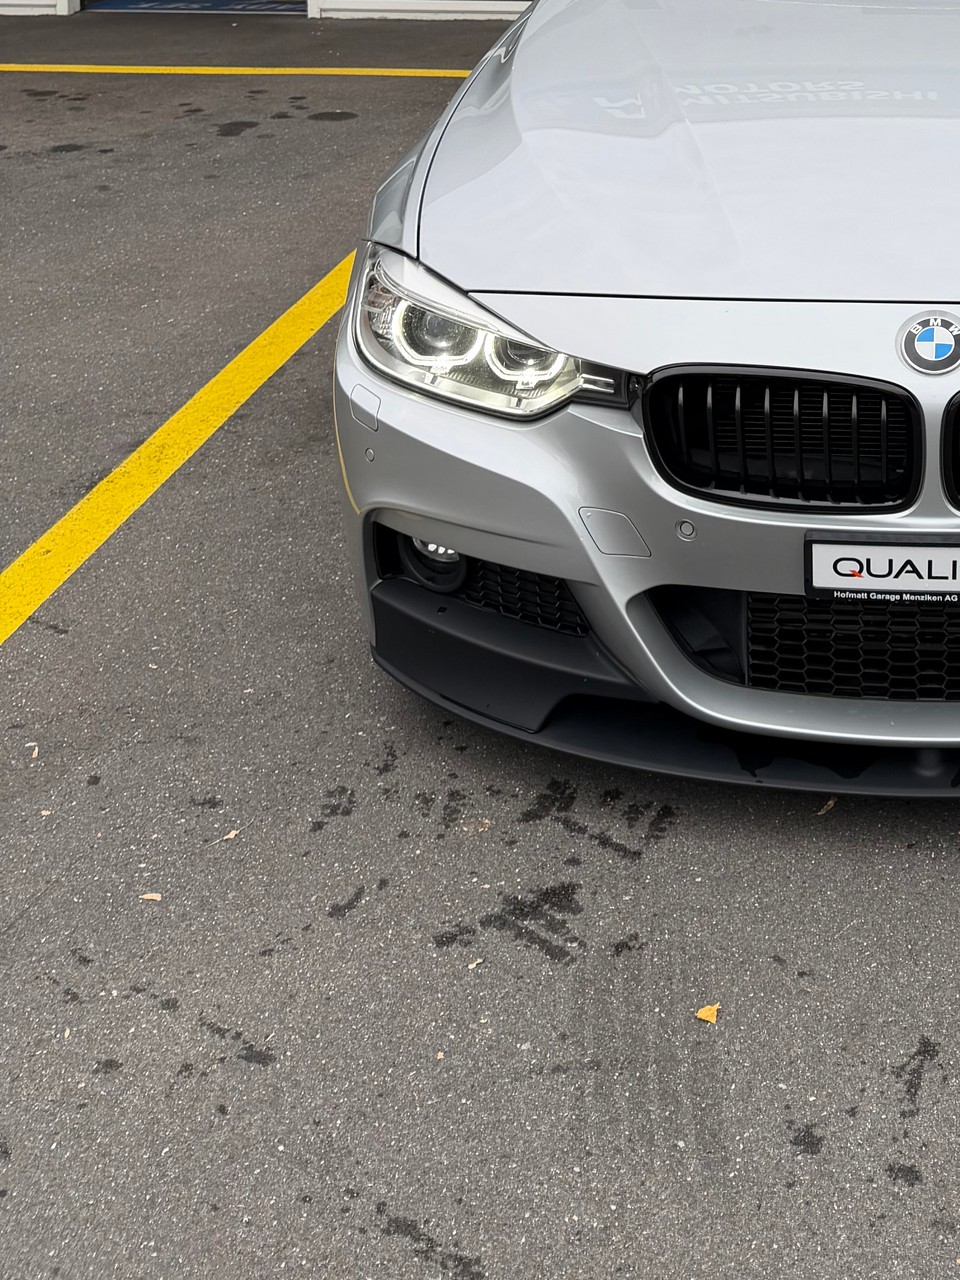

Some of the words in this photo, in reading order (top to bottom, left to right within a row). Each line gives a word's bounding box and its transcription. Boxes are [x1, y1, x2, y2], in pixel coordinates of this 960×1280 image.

[833, 591, 868, 600] Hofmatt
[869, 592, 901, 602] Garage
[902, 593, 943, 602] Menziken
[944, 594, 958, 602] AG
